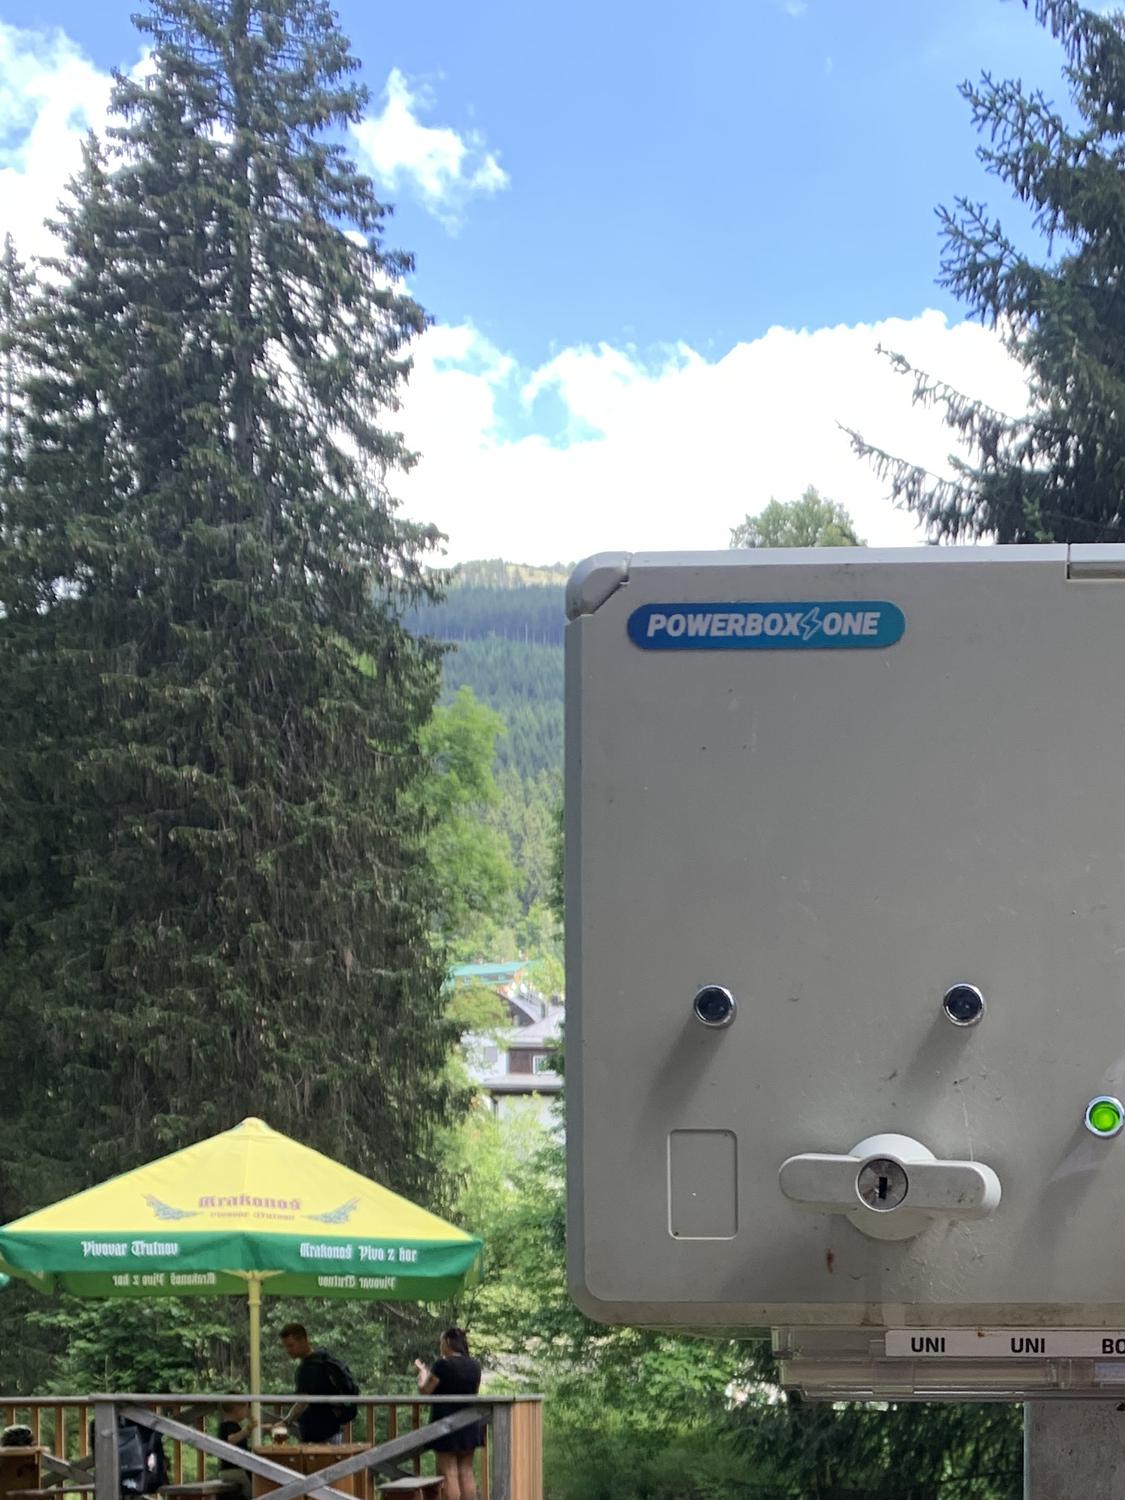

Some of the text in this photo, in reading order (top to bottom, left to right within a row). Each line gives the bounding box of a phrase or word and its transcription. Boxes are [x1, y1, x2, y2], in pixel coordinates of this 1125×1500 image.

[647, 612, 880, 637] POWERBOX ONE
[910, 1336, 946, 1353] UNI
[1010, 1337, 1046, 1353] UNI
